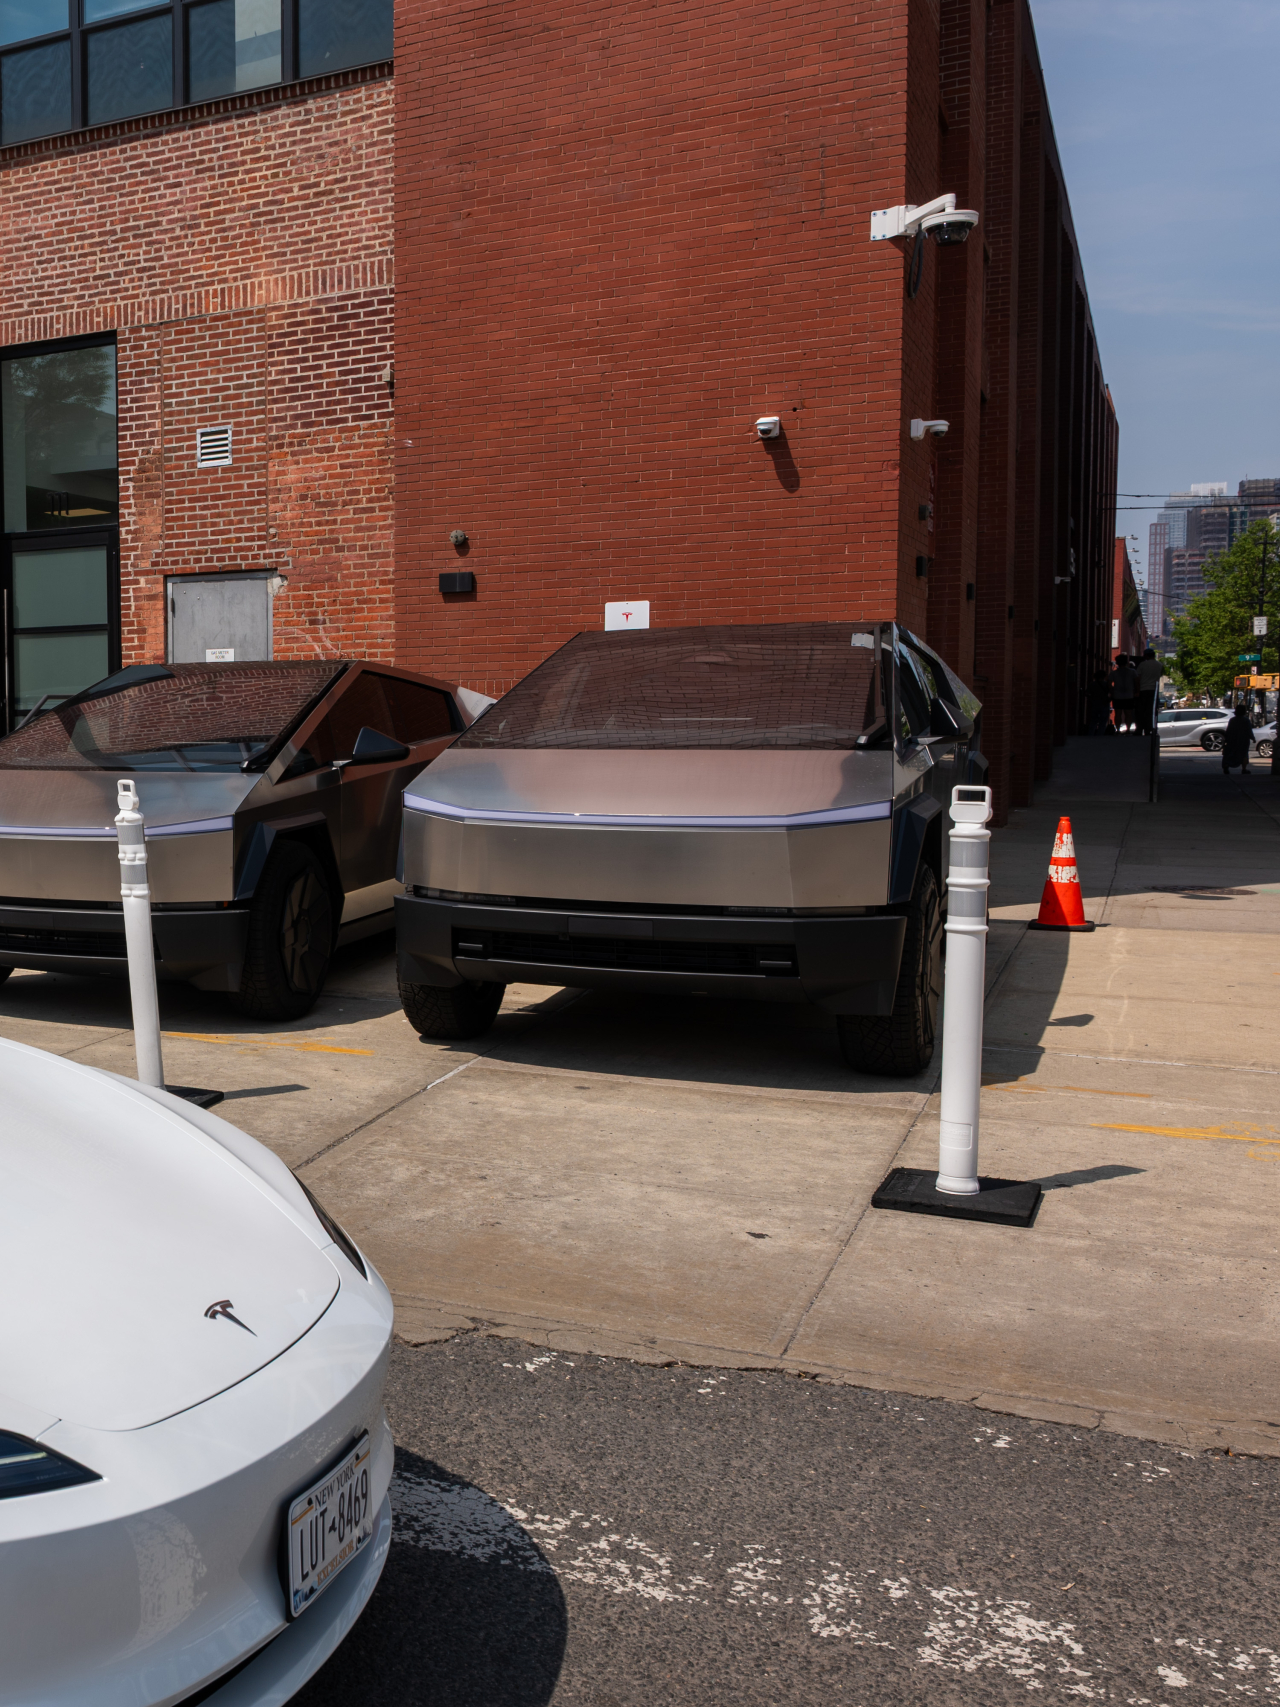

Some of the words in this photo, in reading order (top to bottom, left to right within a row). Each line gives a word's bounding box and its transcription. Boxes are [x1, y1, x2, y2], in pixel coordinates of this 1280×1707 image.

[314, 1482, 335, 1511] NEW
[336, 1462, 355, 1490] YORK
[300, 1505, 328, 1583] LUT
[337, 1468, 368, 1544] 8469
[316, 1538, 355, 1588] EXCELSIOR
